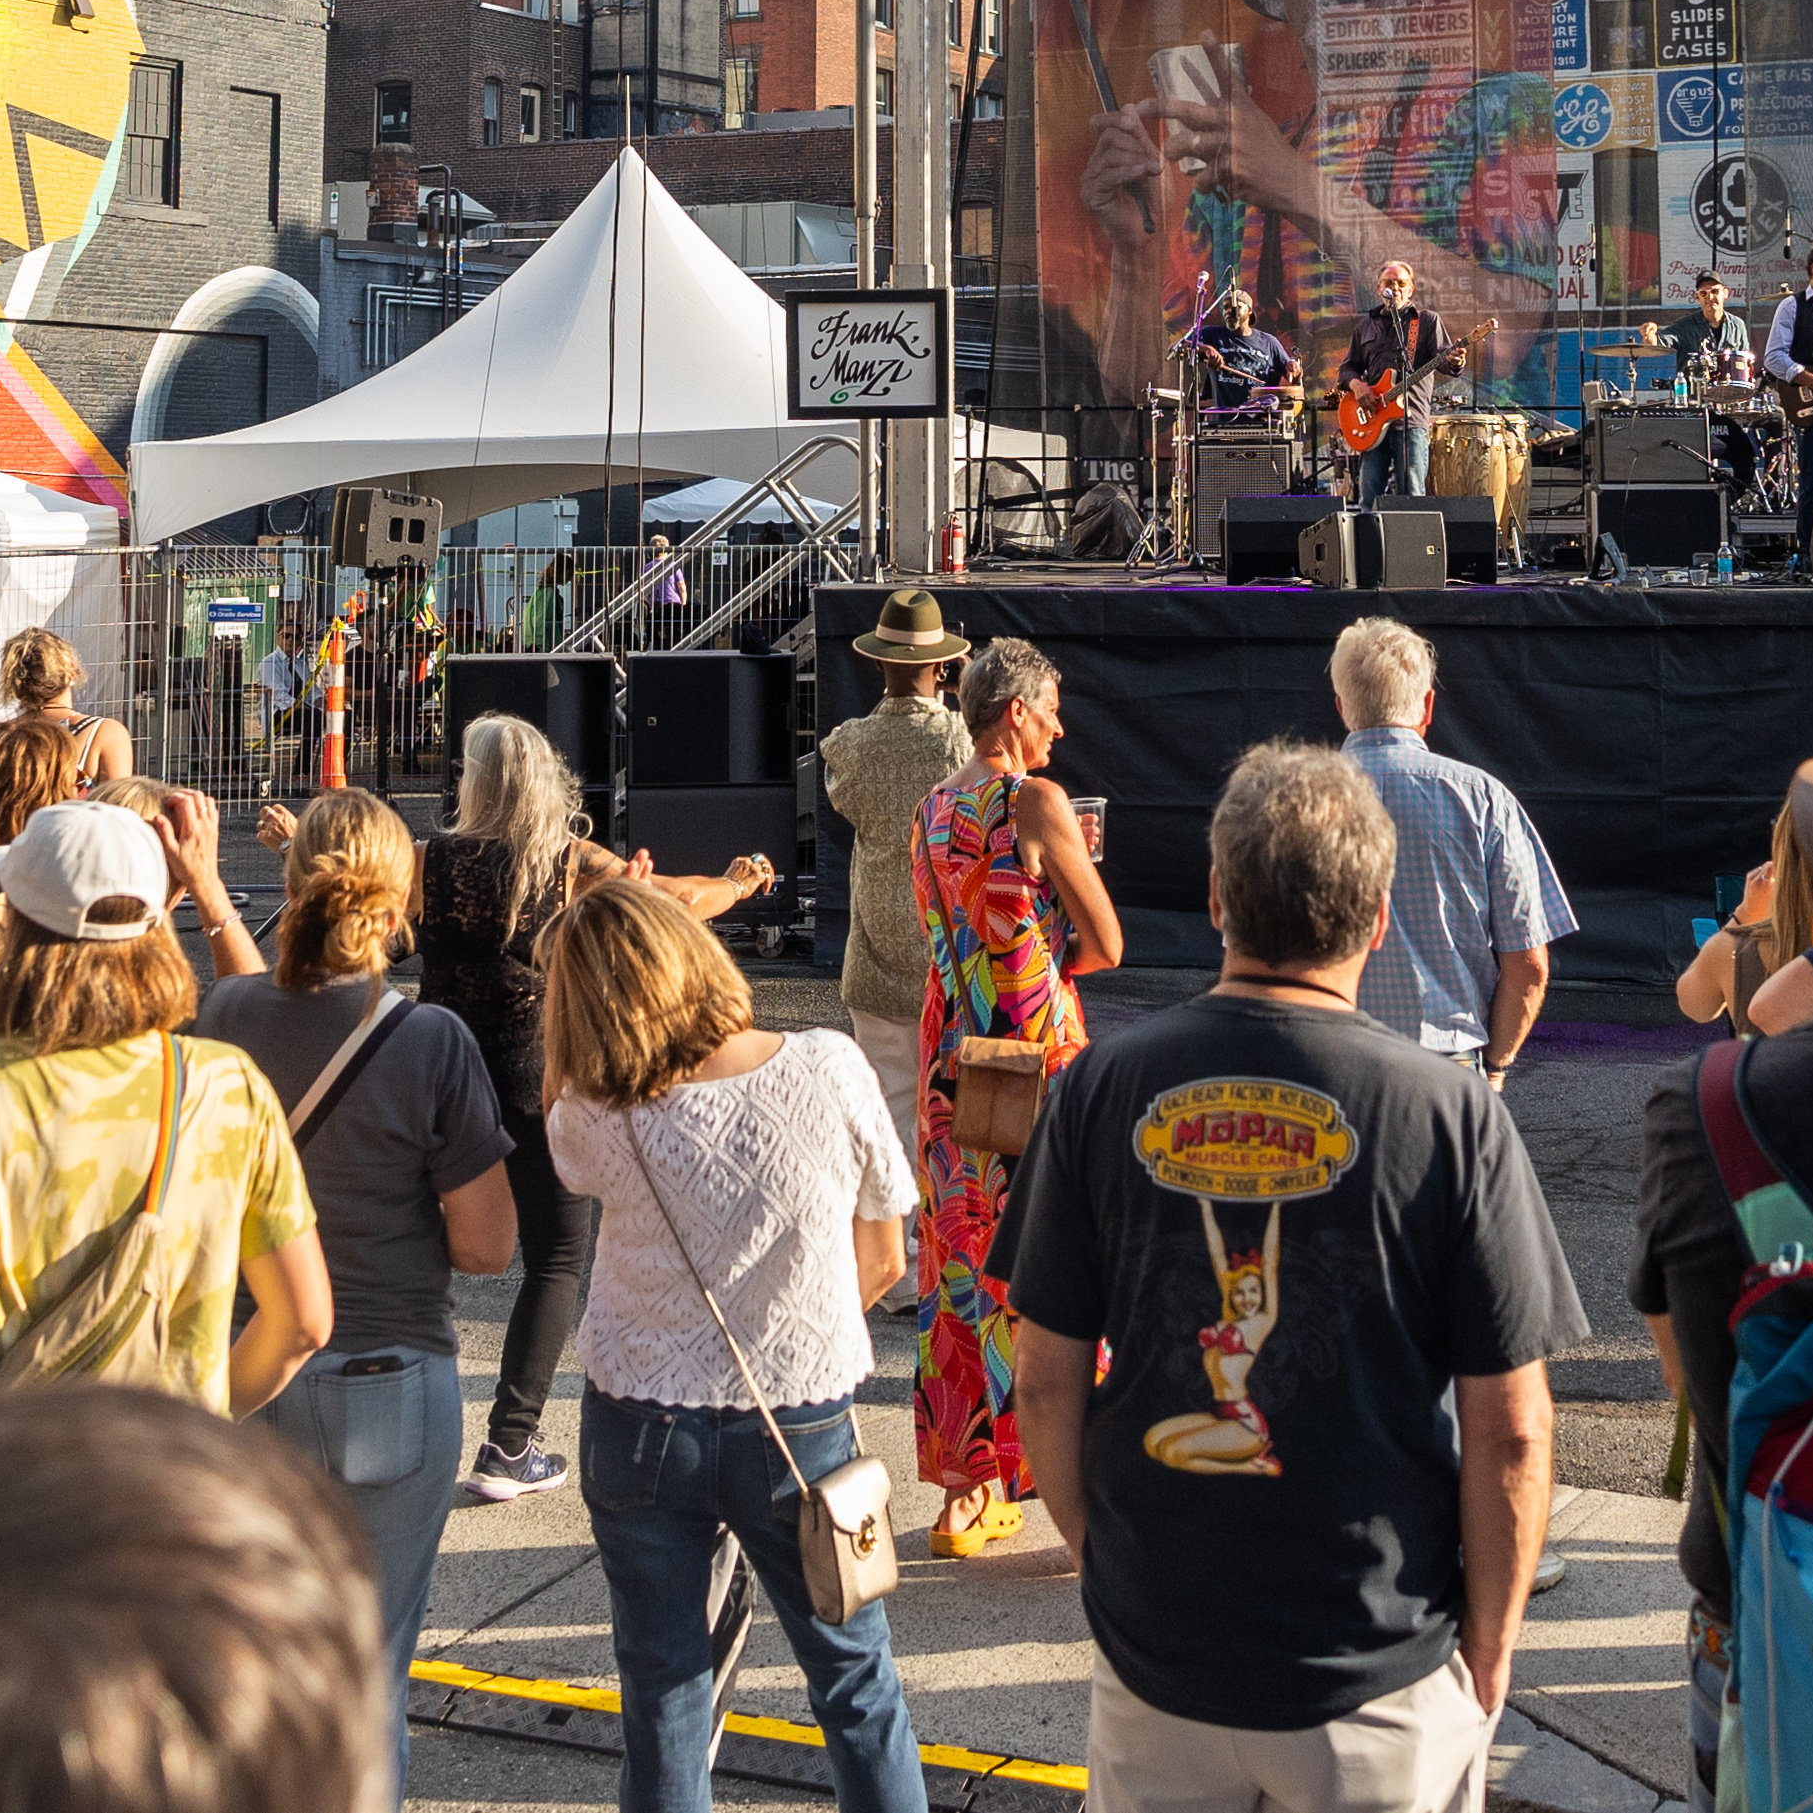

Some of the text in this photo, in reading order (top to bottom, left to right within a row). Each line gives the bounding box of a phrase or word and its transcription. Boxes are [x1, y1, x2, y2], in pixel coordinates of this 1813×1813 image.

[1517, 14, 1577, 26] MOTION
[1670, 7, 1725, 25] SLIDES
[1326, 12, 1470, 39] EDITOR VIEWERS
[1518, 25, 1578, 38] PICTURE
[1671, 24, 1715, 42] FILE
[1662, 41, 1728, 60] CASES
[1553, 55, 1576, 66] 1910
[1726, 67, 1812, 86] CAMERAS
[1618, 94, 1647, 106] MOST
[1676, 85, 1715, 101] argus
[1729, 94, 1813, 112] PROJECTORS
[1613, 125, 1652, 137] PRODUCT
[1753, 121, 1813, 136] COLOR
[1709, 424, 1730, 436] AHA
[1082, 459, 1136, 481] The
[1171, 1111, 1316, 1160] MOPAR
[1185, 1150, 1299, 1168] MUSCLE CARS
[1223, 1177, 1258, 1193] DODGE
